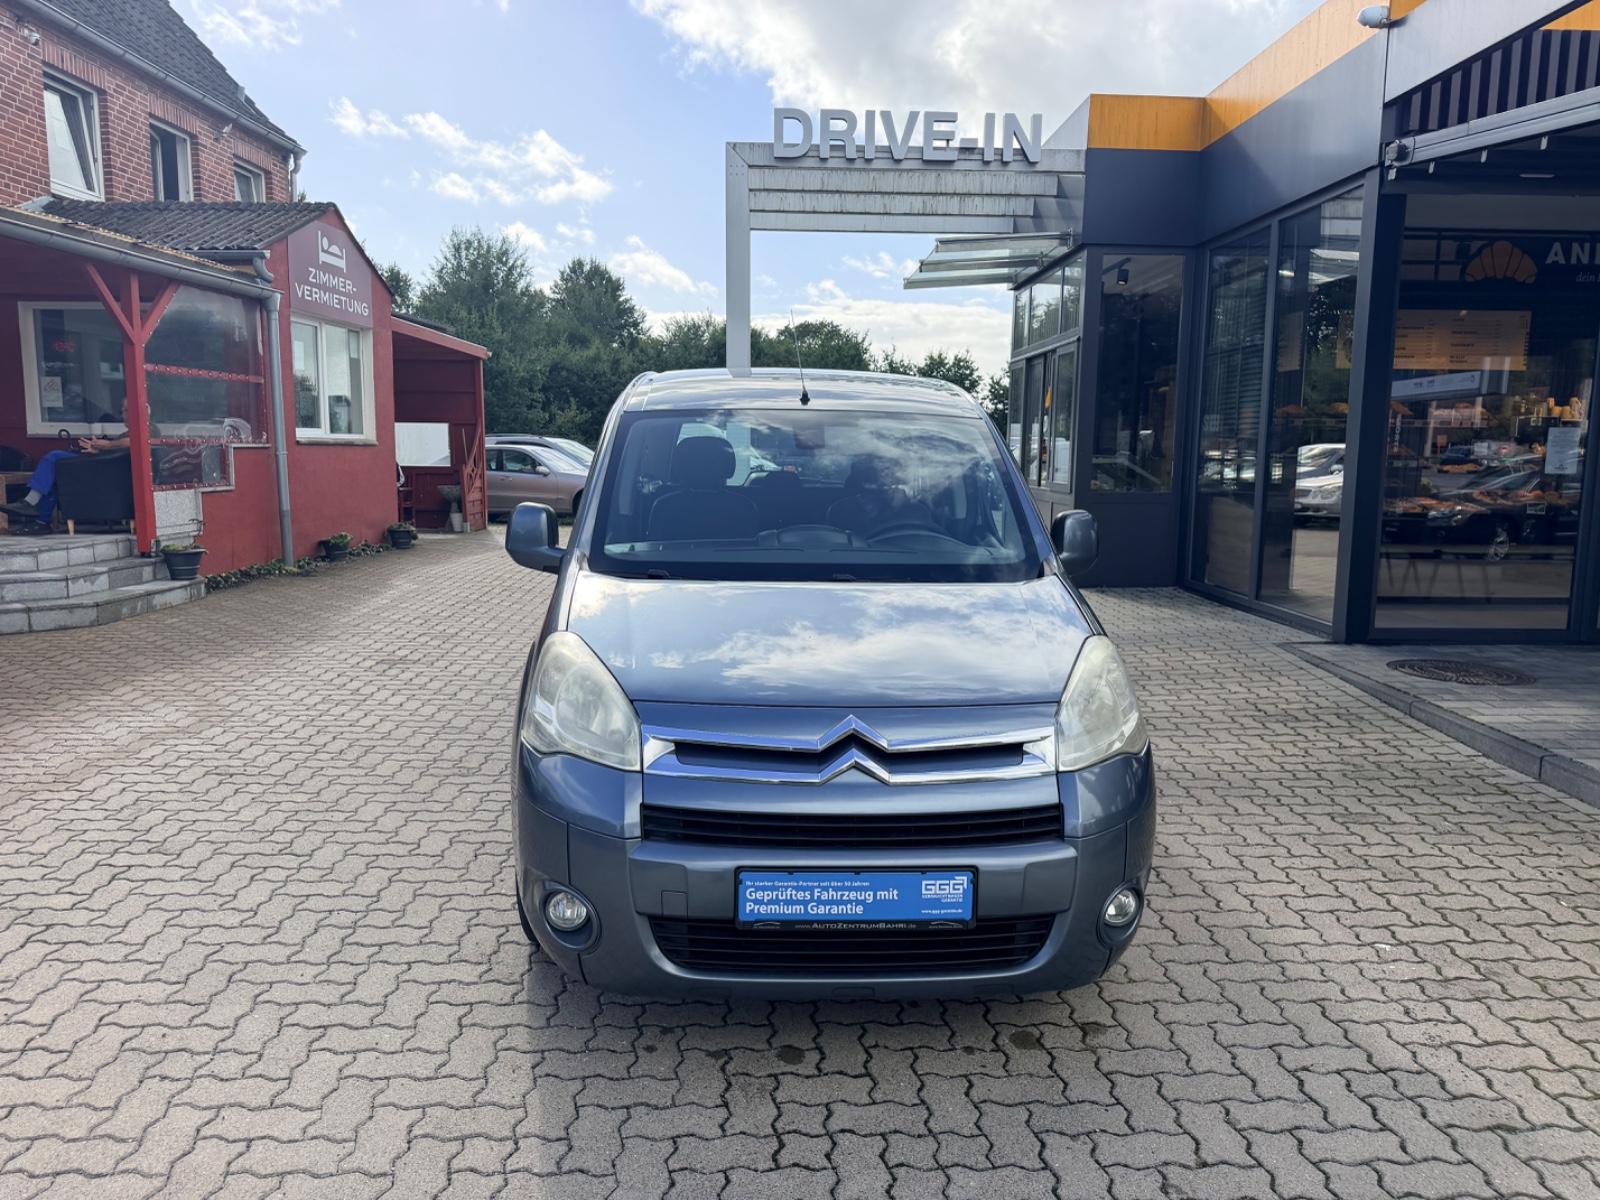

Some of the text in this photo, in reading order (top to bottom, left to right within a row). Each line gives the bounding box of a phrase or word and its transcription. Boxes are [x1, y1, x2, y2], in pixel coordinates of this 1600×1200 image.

[773, 107, 1043, 164] DRIVE-IN
[308, 267, 357, 294] ZIMMER-
[295, 282, 369, 316] VERMIETUNG
[745, 887, 899, 903] Geprüftes Fahrzeug mit
[921, 879, 964, 894] GGG
[745, 902, 864, 914] Premium Garantie
